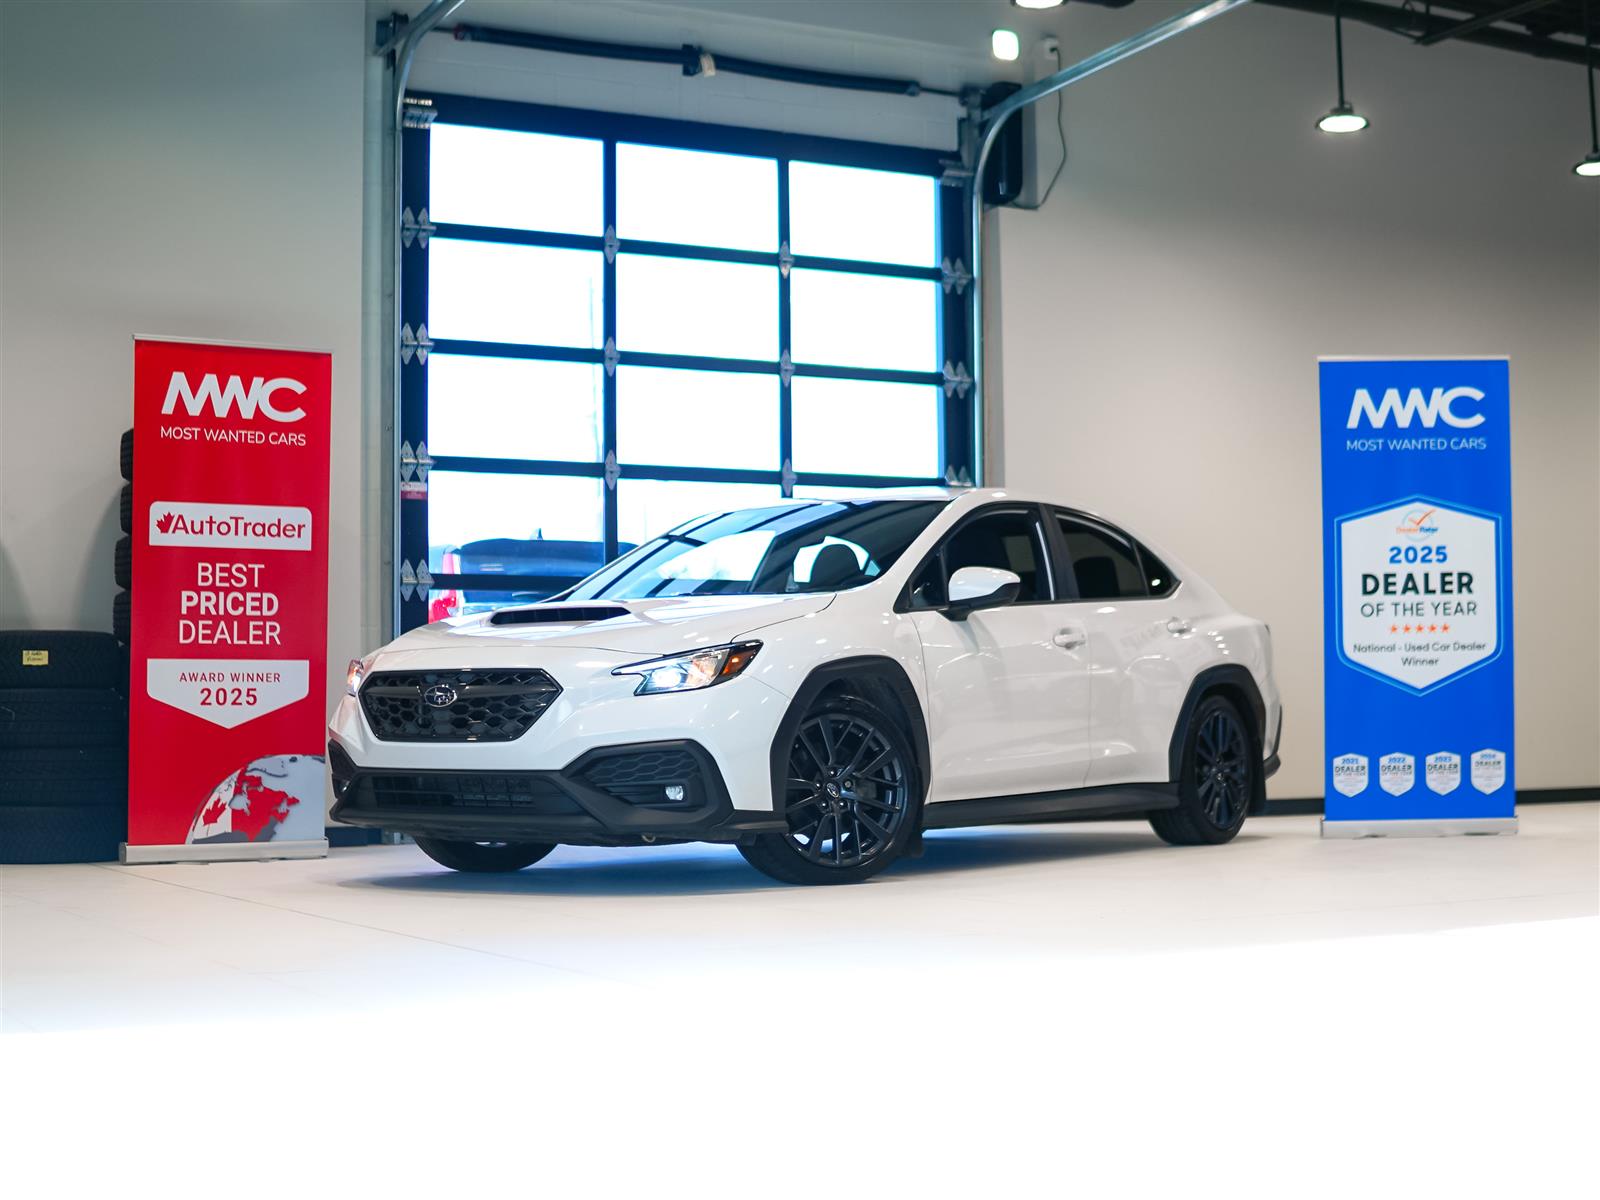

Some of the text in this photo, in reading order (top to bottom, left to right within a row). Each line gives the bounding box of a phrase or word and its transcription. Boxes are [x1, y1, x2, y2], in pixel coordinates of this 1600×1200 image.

[161, 371, 308, 423] MWC
[1346, 386, 1486, 429] MWC
[160, 425, 306, 446] MOST WANTED CARS
[1346, 437, 1487, 451] MOST WANTED CARS
[171, 514, 306, 539] AutoTrader
[1389, 545, 1448, 564] 2025
[197, 562, 265, 588] BEST
[1361, 572, 1474, 595] DEALER
[181, 590, 279, 617] PRICED
[1360, 601, 1477, 618] OF THE YEAR
[178, 619, 281, 645] DEALER
[1353, 643, 1396, 653] National
[1404, 643, 1430, 652] Used
[1432, 642, 1451, 651] Car
[1453, 641, 1486, 651] Dealer
[1401, 656, 1439, 667] Winner
[179, 672, 281, 683] AWARD WINNER
[200, 687, 258, 706] 2025
[1335, 765, 1366, 773] DEALER
[1381, 764, 1412, 772] DEALER
[1427, 763, 1458, 771] DEALER
